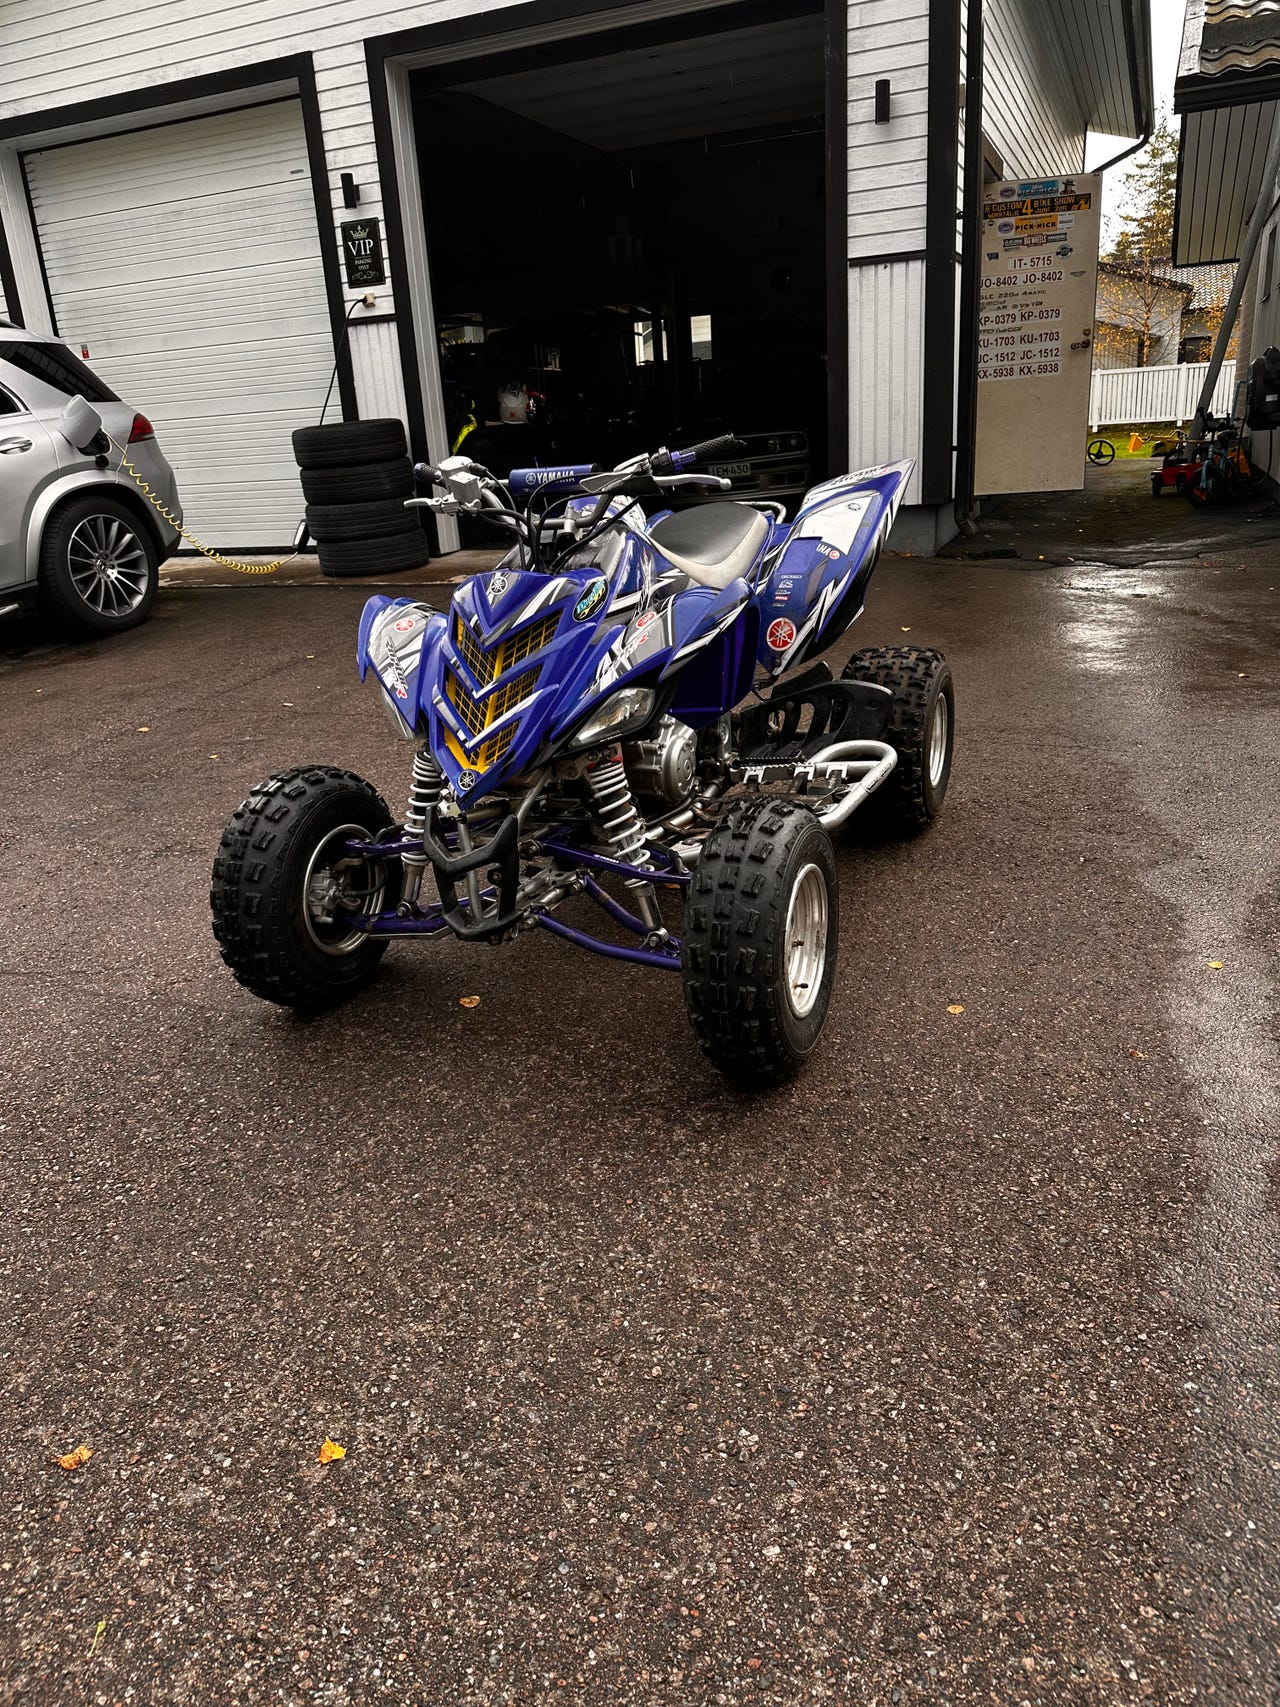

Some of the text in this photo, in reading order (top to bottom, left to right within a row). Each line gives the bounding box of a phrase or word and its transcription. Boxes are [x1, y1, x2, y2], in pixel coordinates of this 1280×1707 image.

[992, 196, 1075, 215] CUSTOM 4 BIKE SHOW
[348, 239, 373, 256] VIP
[980, 271, 1063, 289] JO-8402 JO-8402
[1021, 308, 1060, 321] KP-0379
[1020, 331, 1060, 344] KU-1703
[1020, 348, 1060, 360] JC-1512
[1019, 363, 1059, 376] KX-5938
[537, 470, 576, 484] YAMAHA
